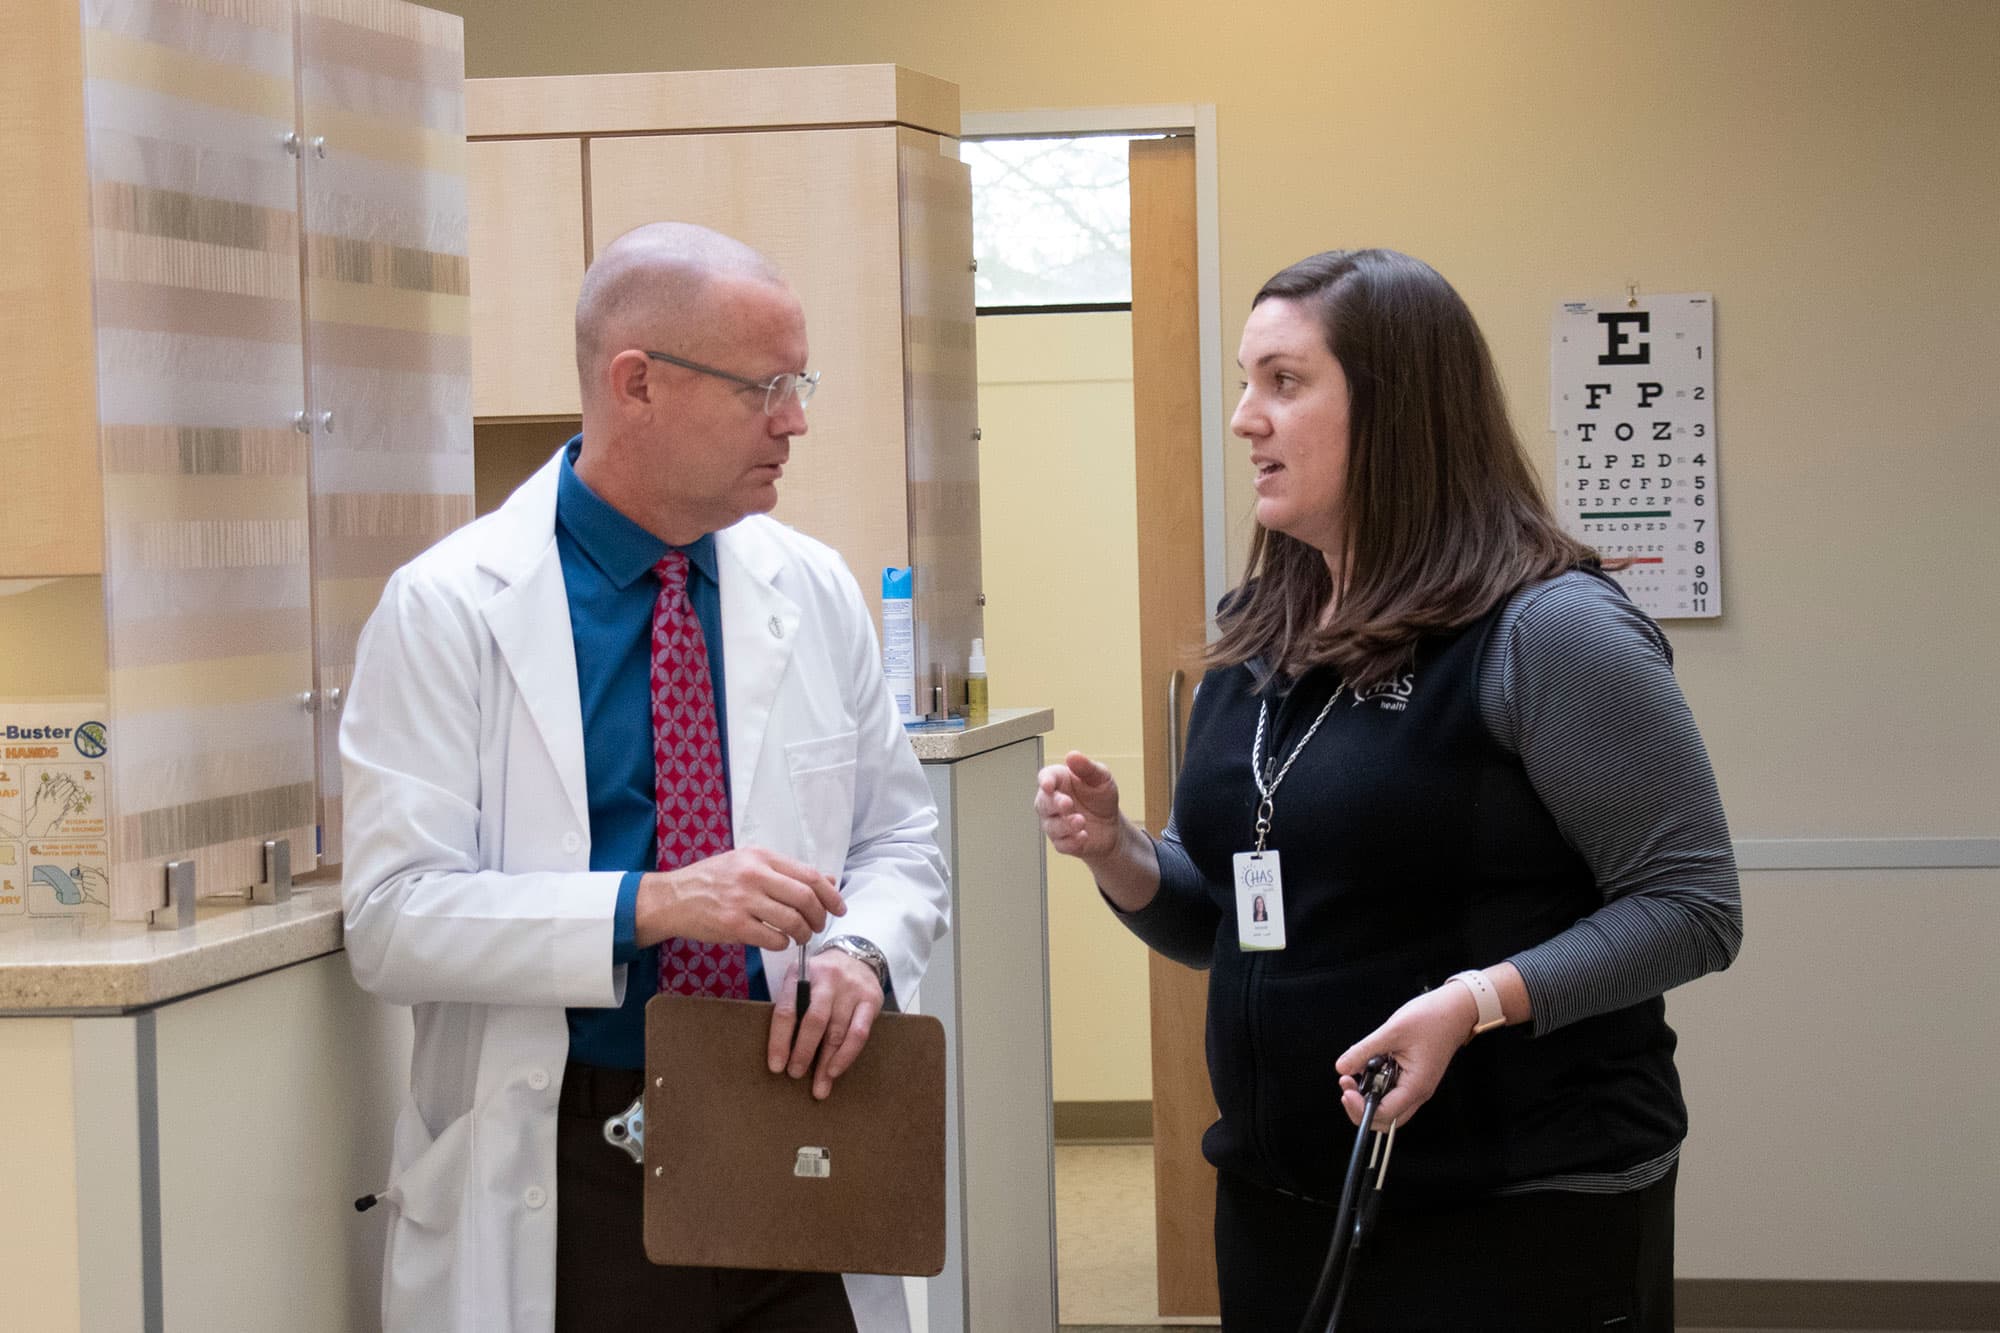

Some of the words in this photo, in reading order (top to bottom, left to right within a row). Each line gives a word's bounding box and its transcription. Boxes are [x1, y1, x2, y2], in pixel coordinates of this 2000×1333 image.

[1597, 311, 1651, 366] E
[1695, 346, 1702, 360] 1
[1584, 383, 1612, 410] F
[1636, 382, 1664, 409] P
[1693, 386, 1705, 400] 2
[1577, 423, 1597, 442] T
[1614, 422, 1634, 442] O
[1652, 421, 1672, 441] Z
[1693, 424, 1705, 438] 3
[1577, 455, 1592, 469] L
[1604, 454, 1618, 469] P
[1631, 454, 1645, 468] E
[1657, 453, 1672, 468] D
[1692, 453, 1707, 467] 4
[1694, 475, 1705, 490] 5
[1694, 494, 1705, 507] 6
[1693, 519, 1705, 533] 7
[1694, 540, 1705, 555] 8
[1694, 565, 1705, 578] 9
[1692, 581, 1709, 596] 10
[1692, 598, 1706, 612] 11
[5, 746, 59, 759] HANDS
[1244, 868, 1274, 888] CHAS
